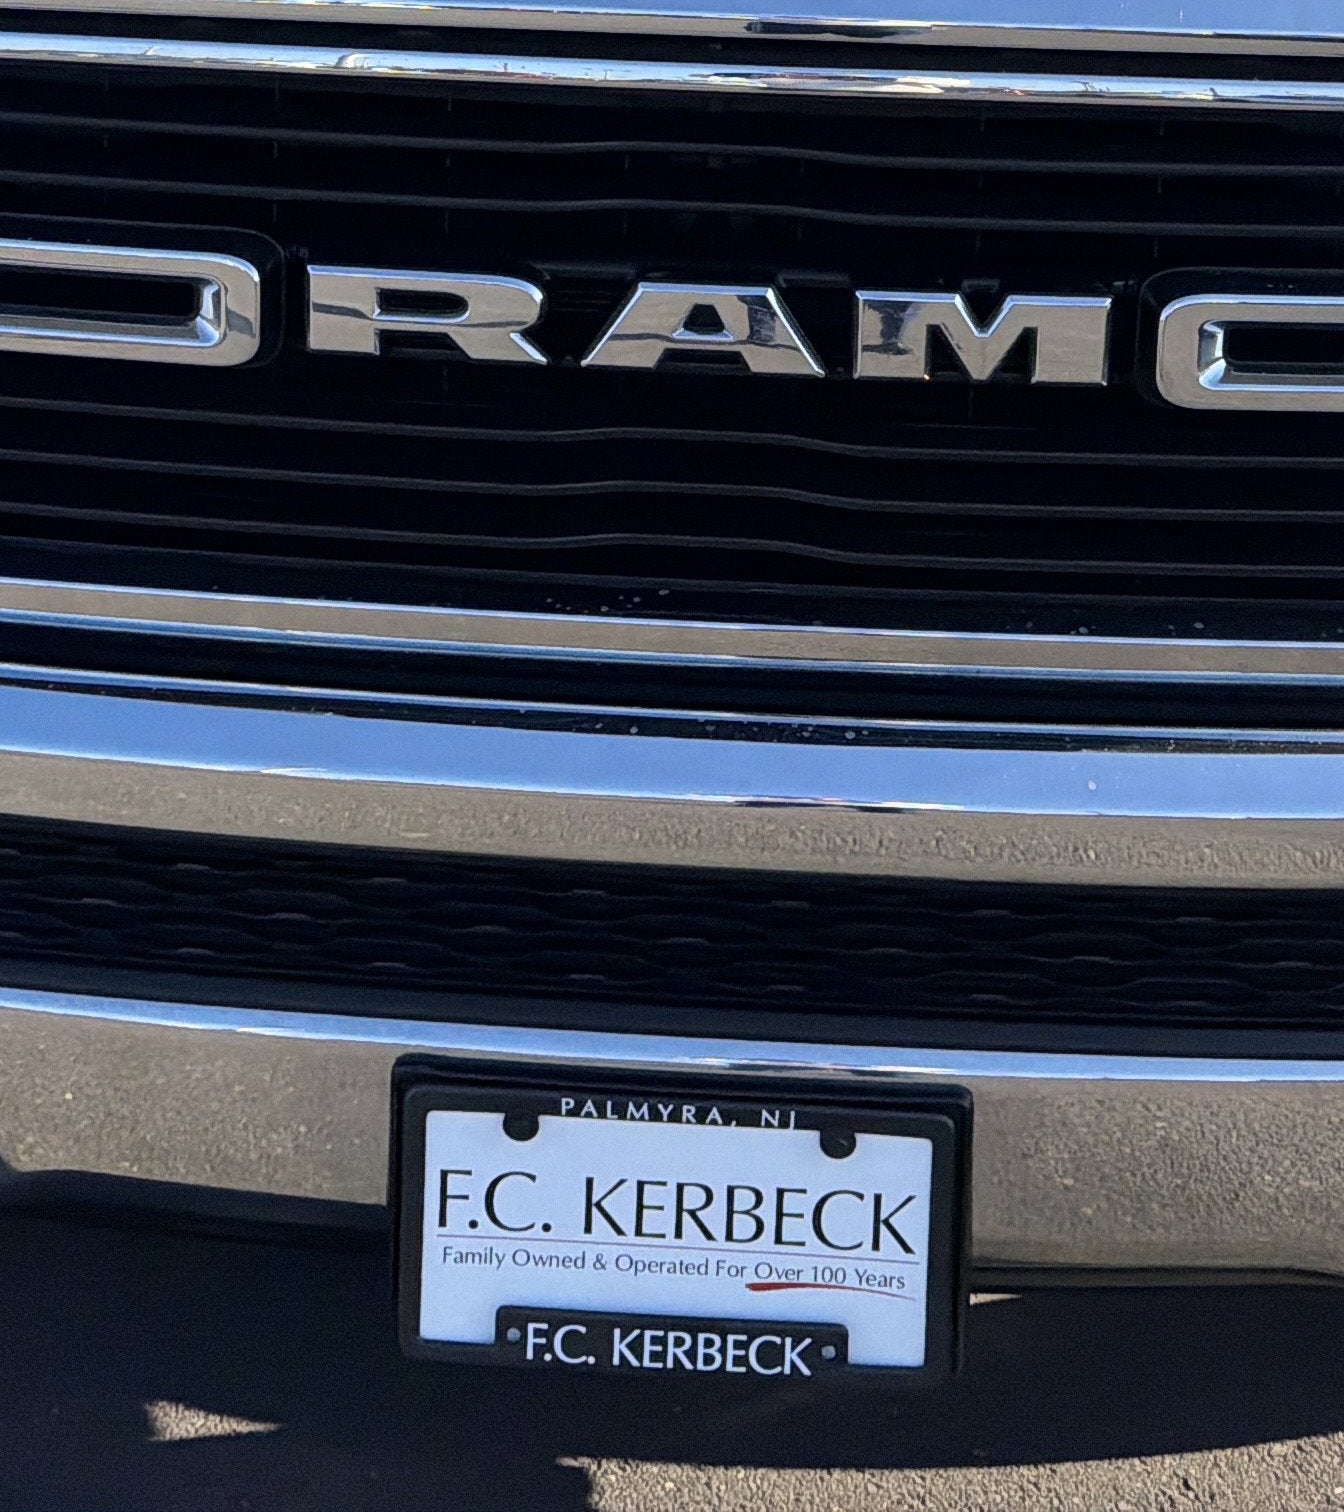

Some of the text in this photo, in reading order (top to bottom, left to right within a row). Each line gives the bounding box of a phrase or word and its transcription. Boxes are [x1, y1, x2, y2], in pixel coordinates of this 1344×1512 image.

[307, 263, 1113, 387] RAM
[560, 1097, 796, 1130] PALMYRA, NJ
[438, 1168, 917, 1255] F.C. KERBECK
[442, 1246, 906, 1289] Family Owned & Operated For Over 100 Years
[525, 1322, 813, 1376] F.C. KERBECK
